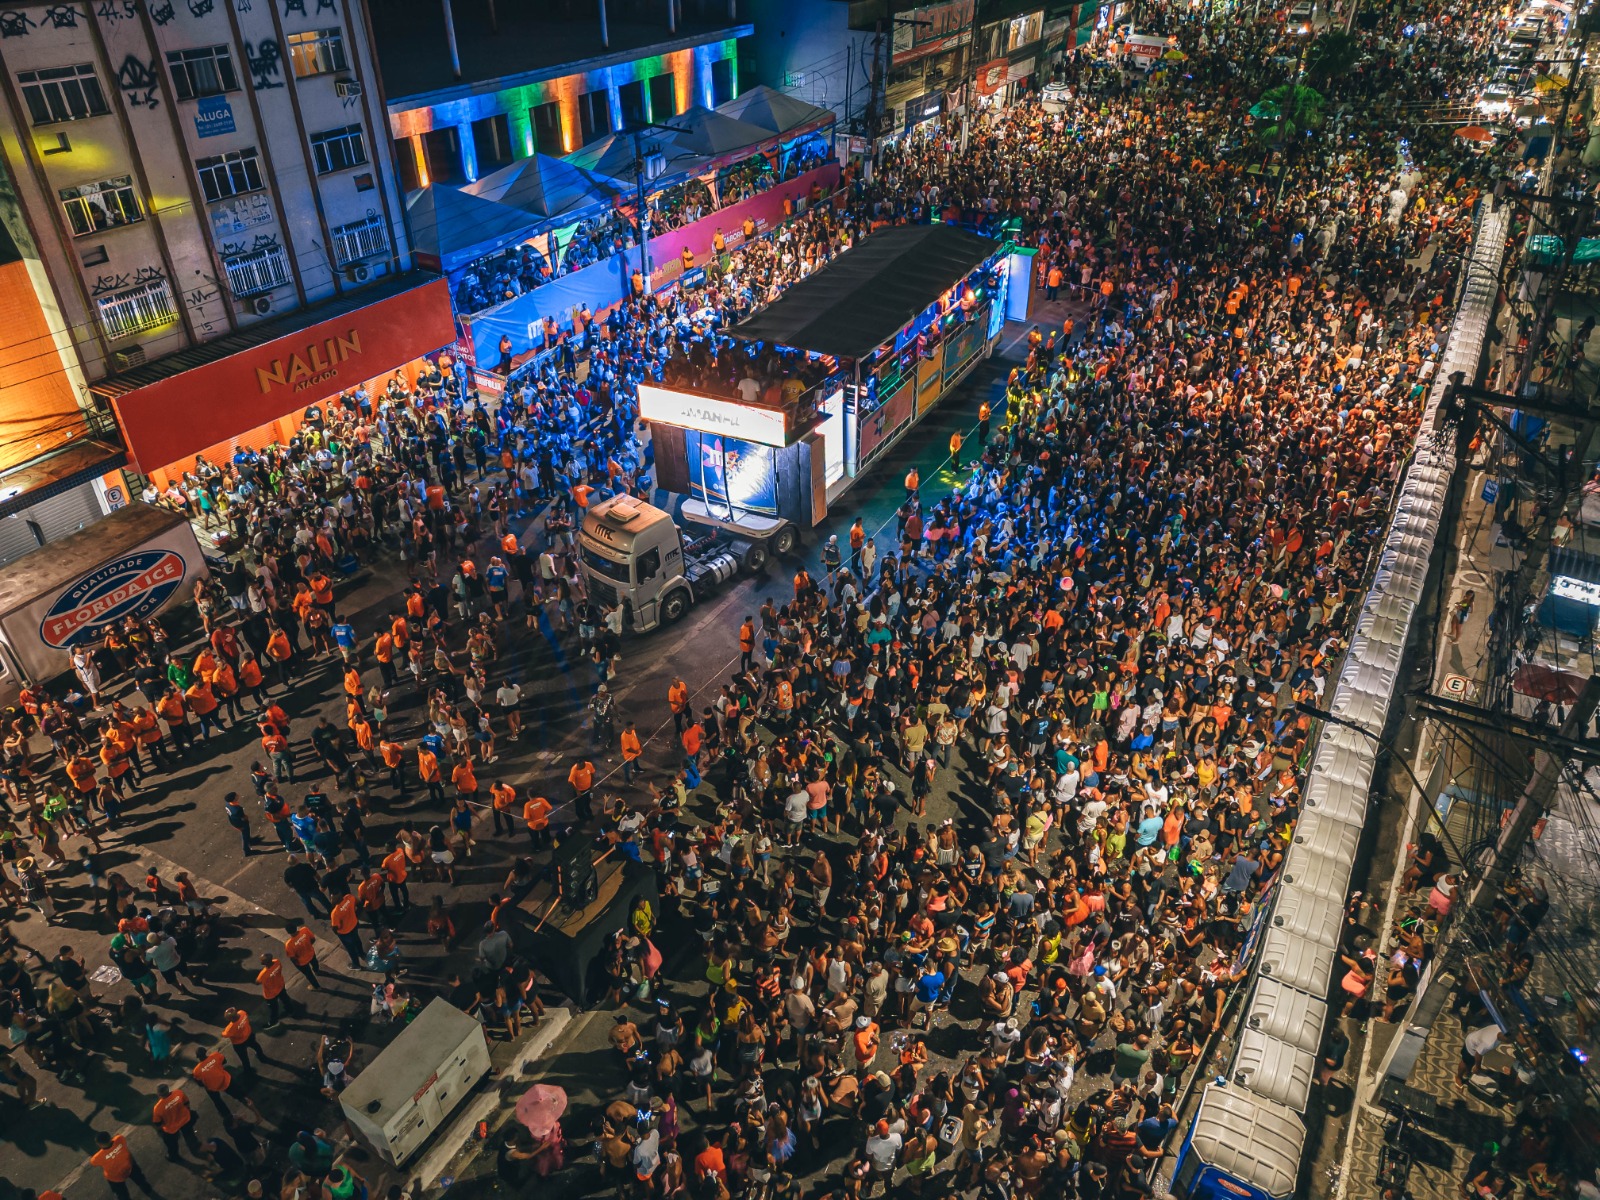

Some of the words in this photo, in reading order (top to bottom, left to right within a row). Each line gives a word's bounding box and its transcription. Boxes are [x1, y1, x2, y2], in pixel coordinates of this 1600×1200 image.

[197, 109, 230, 123] ALUGA
[256, 329, 362, 394] NALIN
[294, 369, 338, 393] ATACADO
[110, 491, 118, 500] E
[72, 558, 143, 599] QUALIDADE
[52, 583, 142, 636] FLORIDA
[145, 562, 175, 586] ICE
[1451, 679, 1461, 690] E
